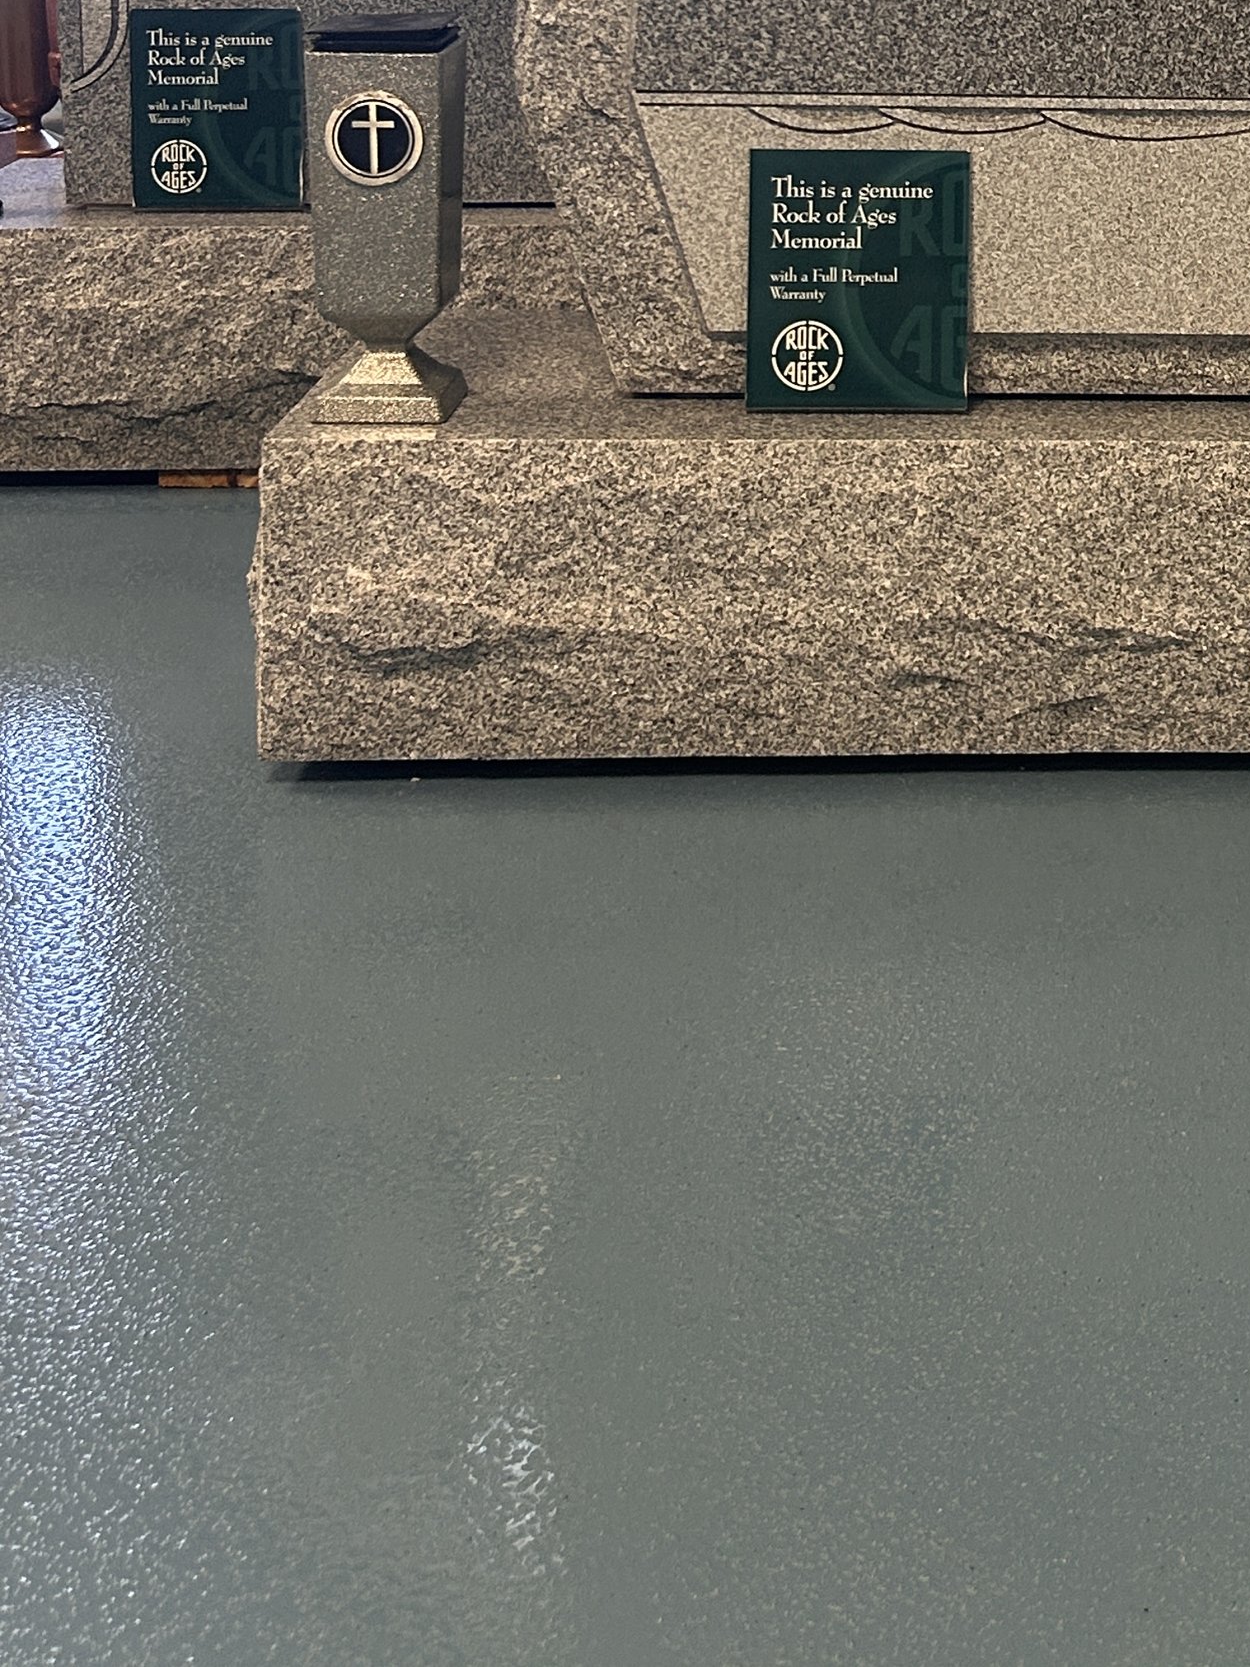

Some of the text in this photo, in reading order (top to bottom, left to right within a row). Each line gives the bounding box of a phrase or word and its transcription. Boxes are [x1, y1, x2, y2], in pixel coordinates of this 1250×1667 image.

[146, 28, 273, 48] This is a genuine
[147, 47, 245, 69] Rock of Ages
[147, 67, 219, 85] Memorial
[148, 97, 248, 113] with a Full Perpetual
[148, 113, 192, 127] Warranty
[161, 144, 196, 162] ROCK
[173, 162, 185, 171] OF
[161, 171, 196, 189] AGES
[771, 174, 934, 203] This is a genuine
[771, 200, 897, 229] Rock of Ages
[770, 226, 862, 249] Memorial
[770, 266, 898, 286] with a Full Perpetual
[769, 286, 826, 303] Warranty
[785, 326, 829, 350] ROCK
[799, 350, 815, 361] OF
[783, 361, 829, 386] AGES
